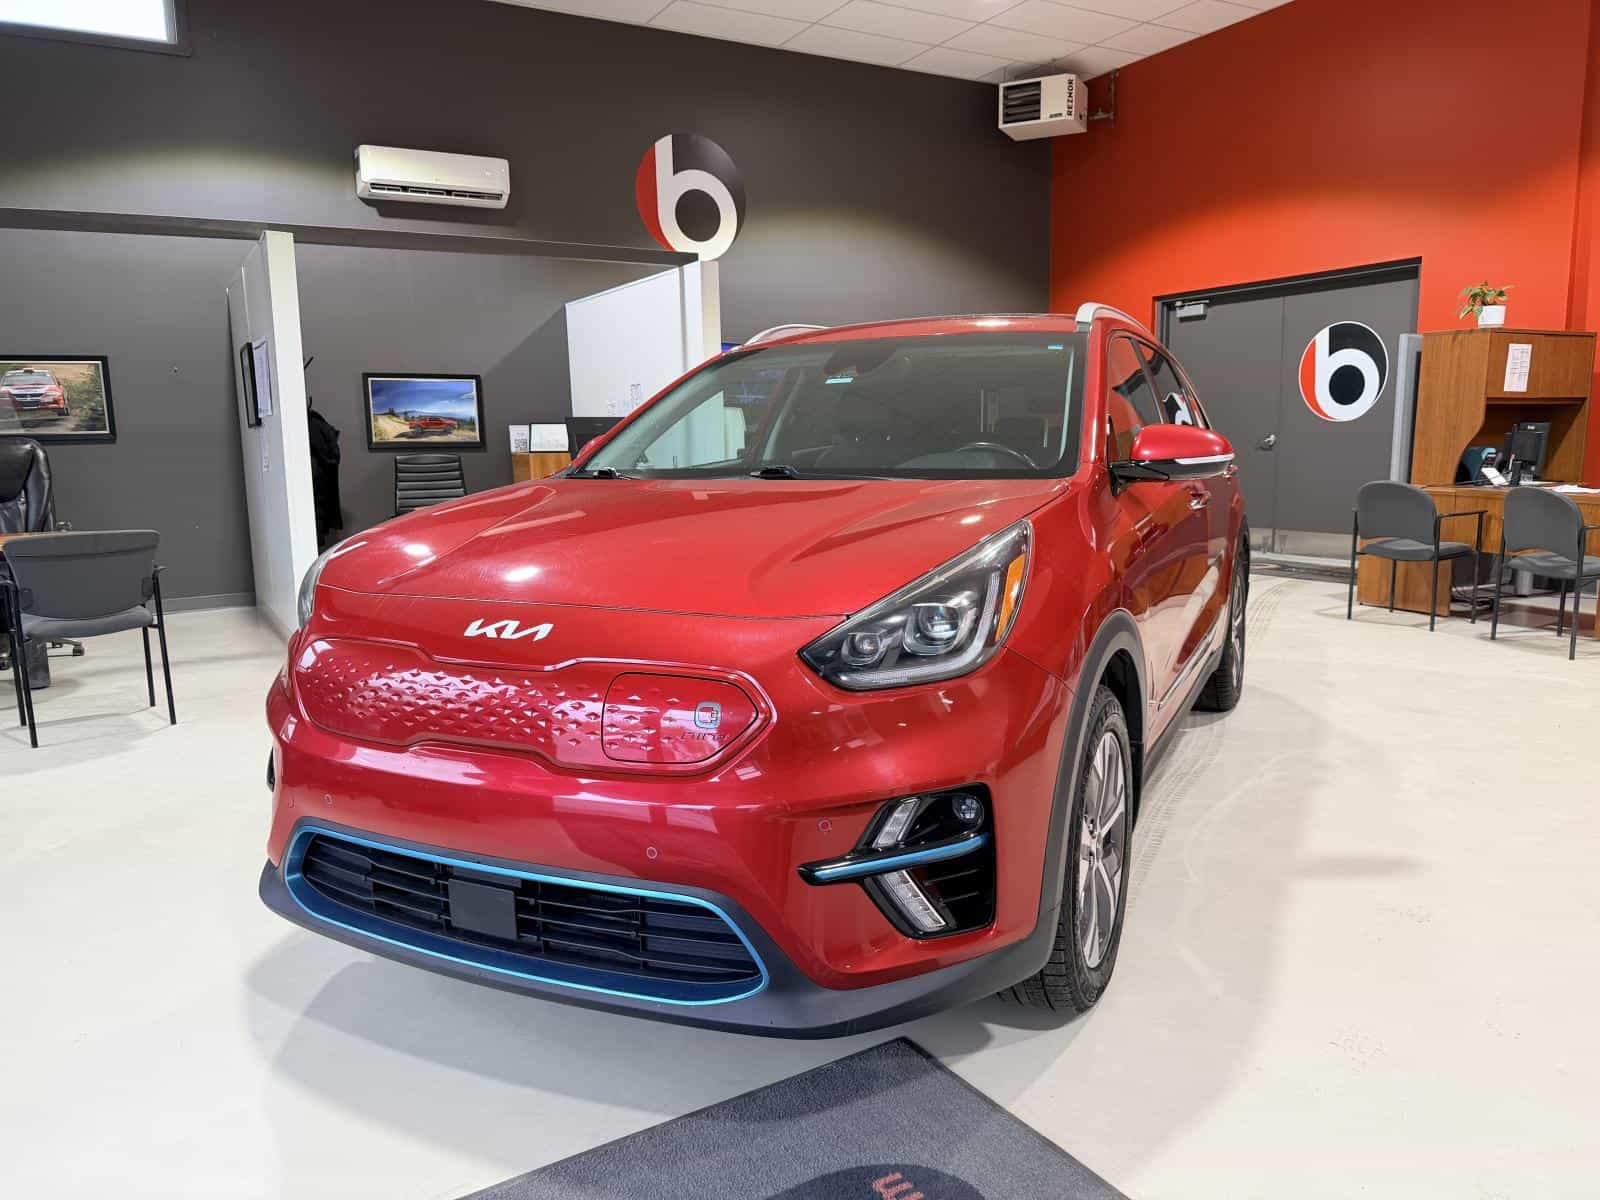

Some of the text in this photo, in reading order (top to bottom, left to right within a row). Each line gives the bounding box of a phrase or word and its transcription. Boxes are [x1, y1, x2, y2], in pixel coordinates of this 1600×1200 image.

[1066, 79, 1074, 116] REZNOR
[653, 134, 738, 261] b
[1313, 325, 1380, 421] b
[463, 618, 554, 641] KIA
